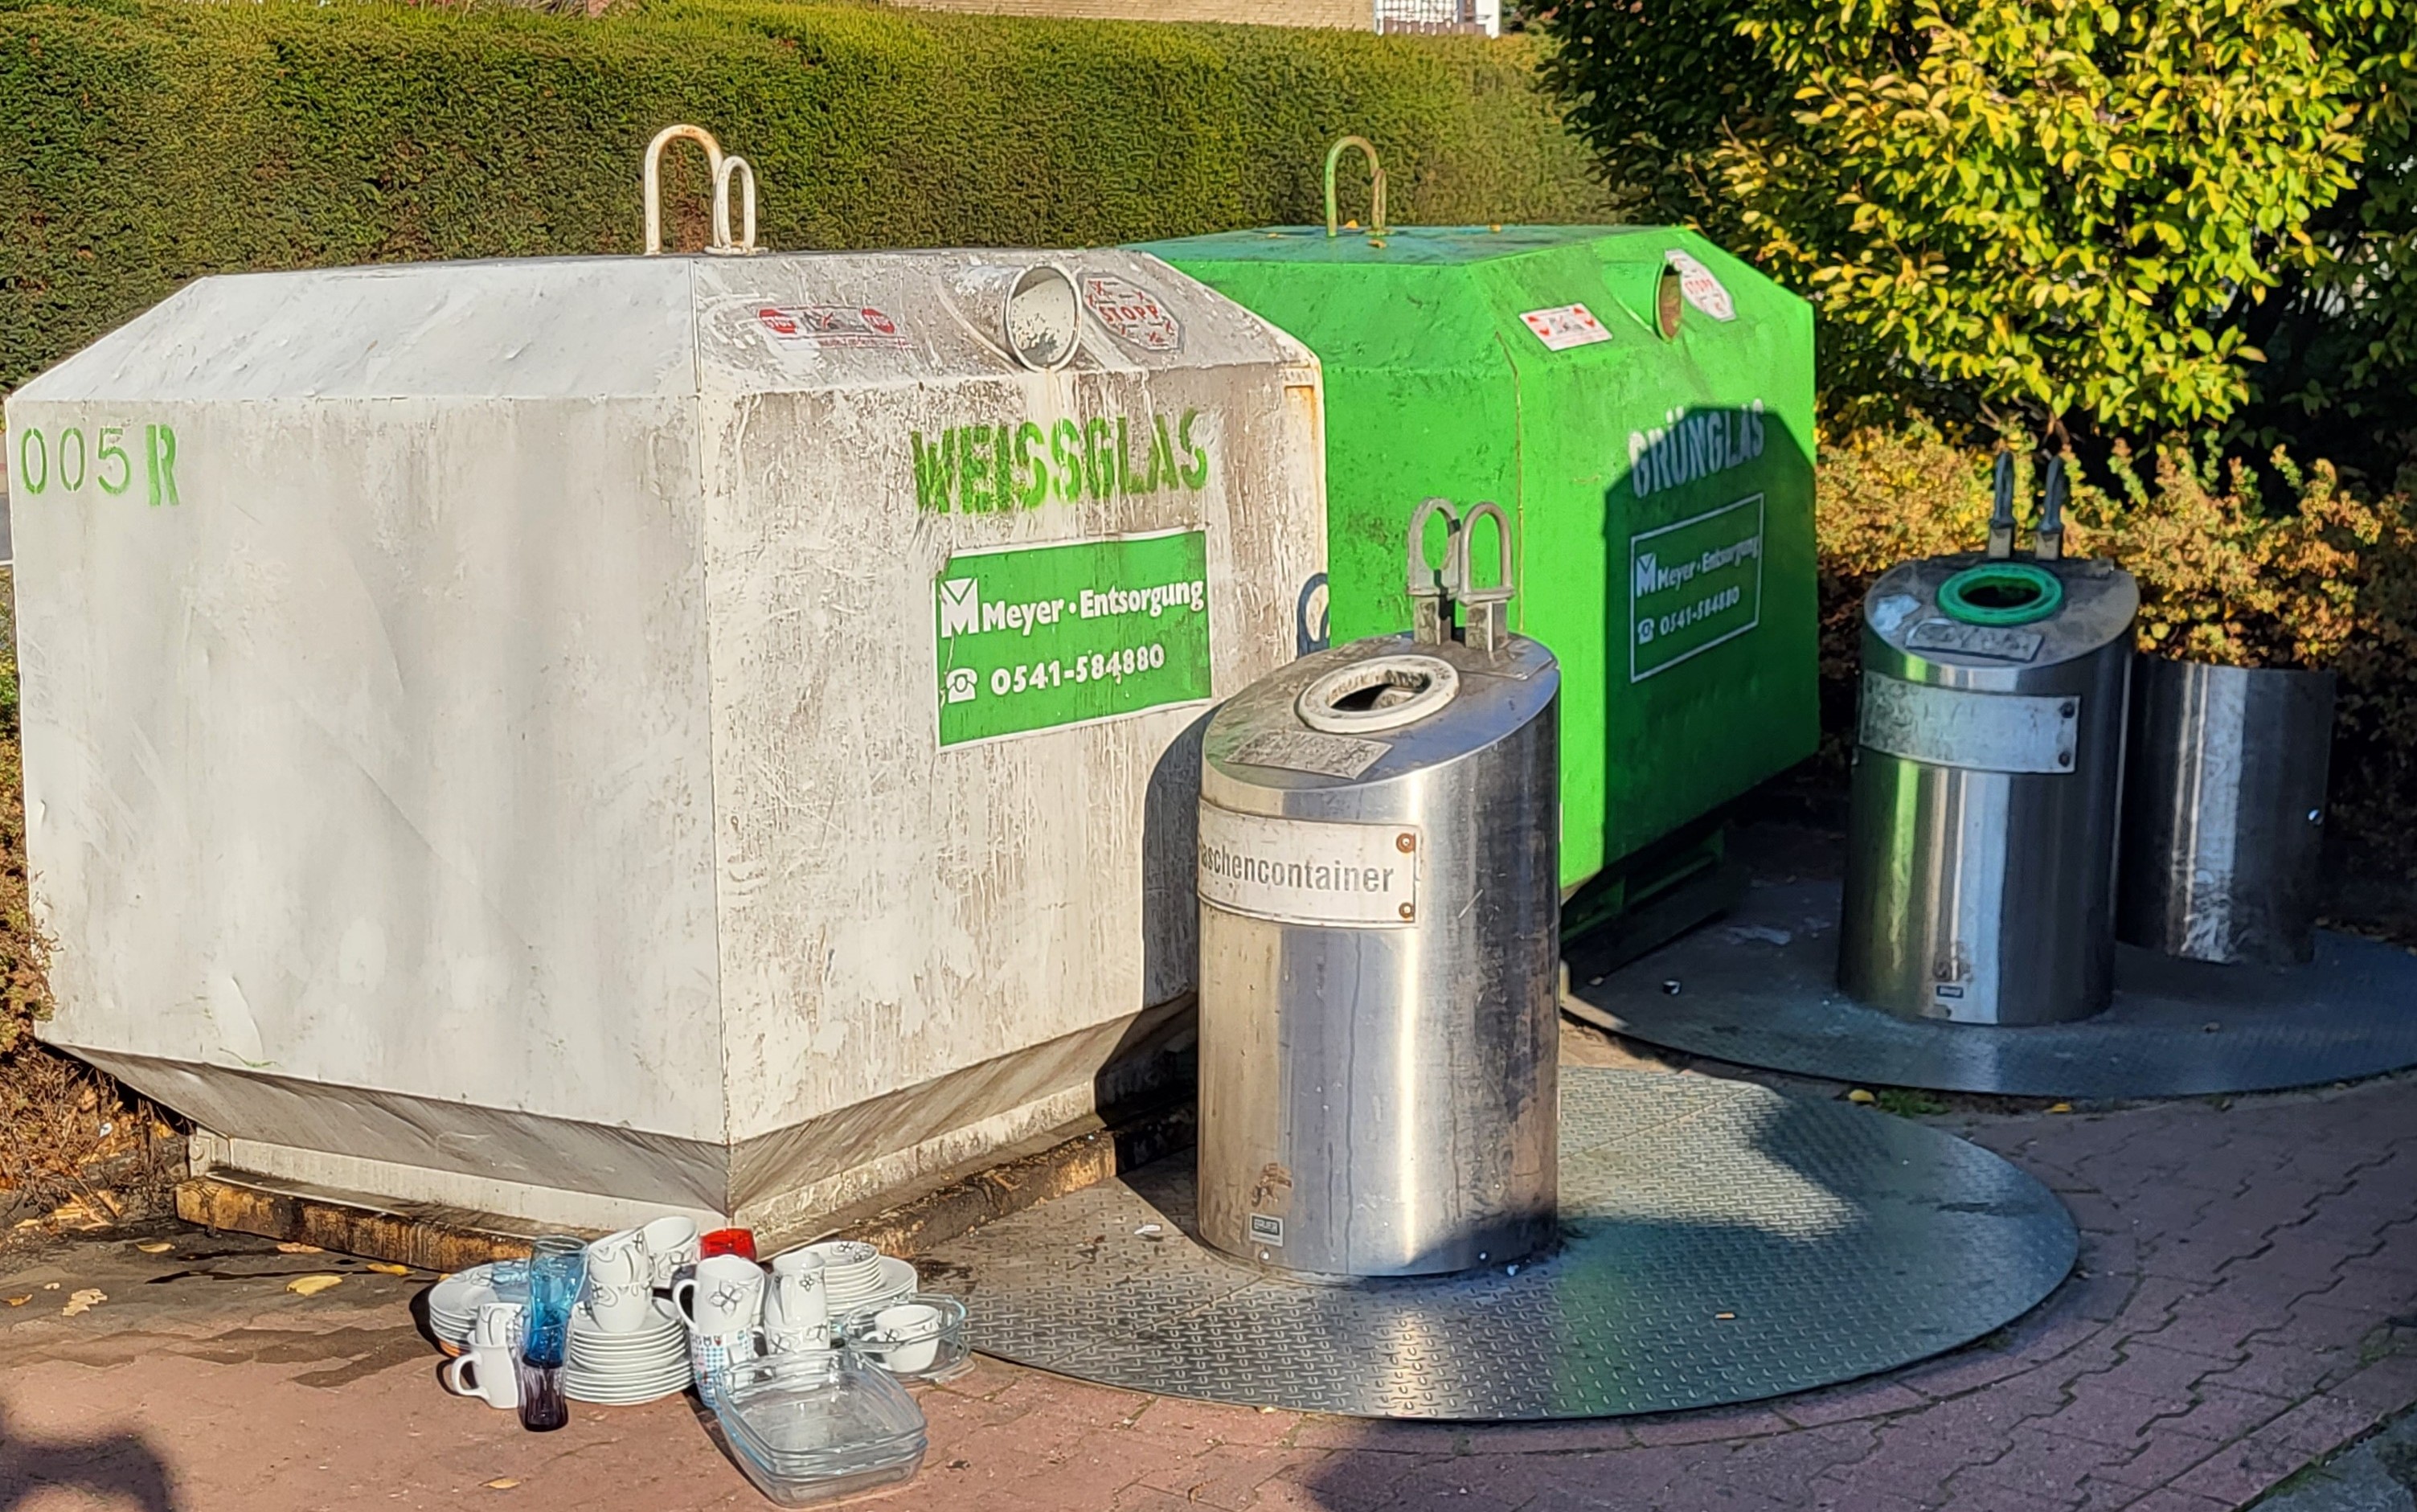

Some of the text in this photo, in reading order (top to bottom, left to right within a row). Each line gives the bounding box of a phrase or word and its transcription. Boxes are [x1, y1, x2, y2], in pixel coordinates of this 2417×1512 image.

[1099, 305, 1158, 322] STOPP
[911, 408, 1207, 514] WEISSGLAS
[1628, 398, 1764, 498] GRÜNGLAS
[990, 643, 1165, 696] 0541-584880
[1198, 841, 1394, 892] aschencontainer
